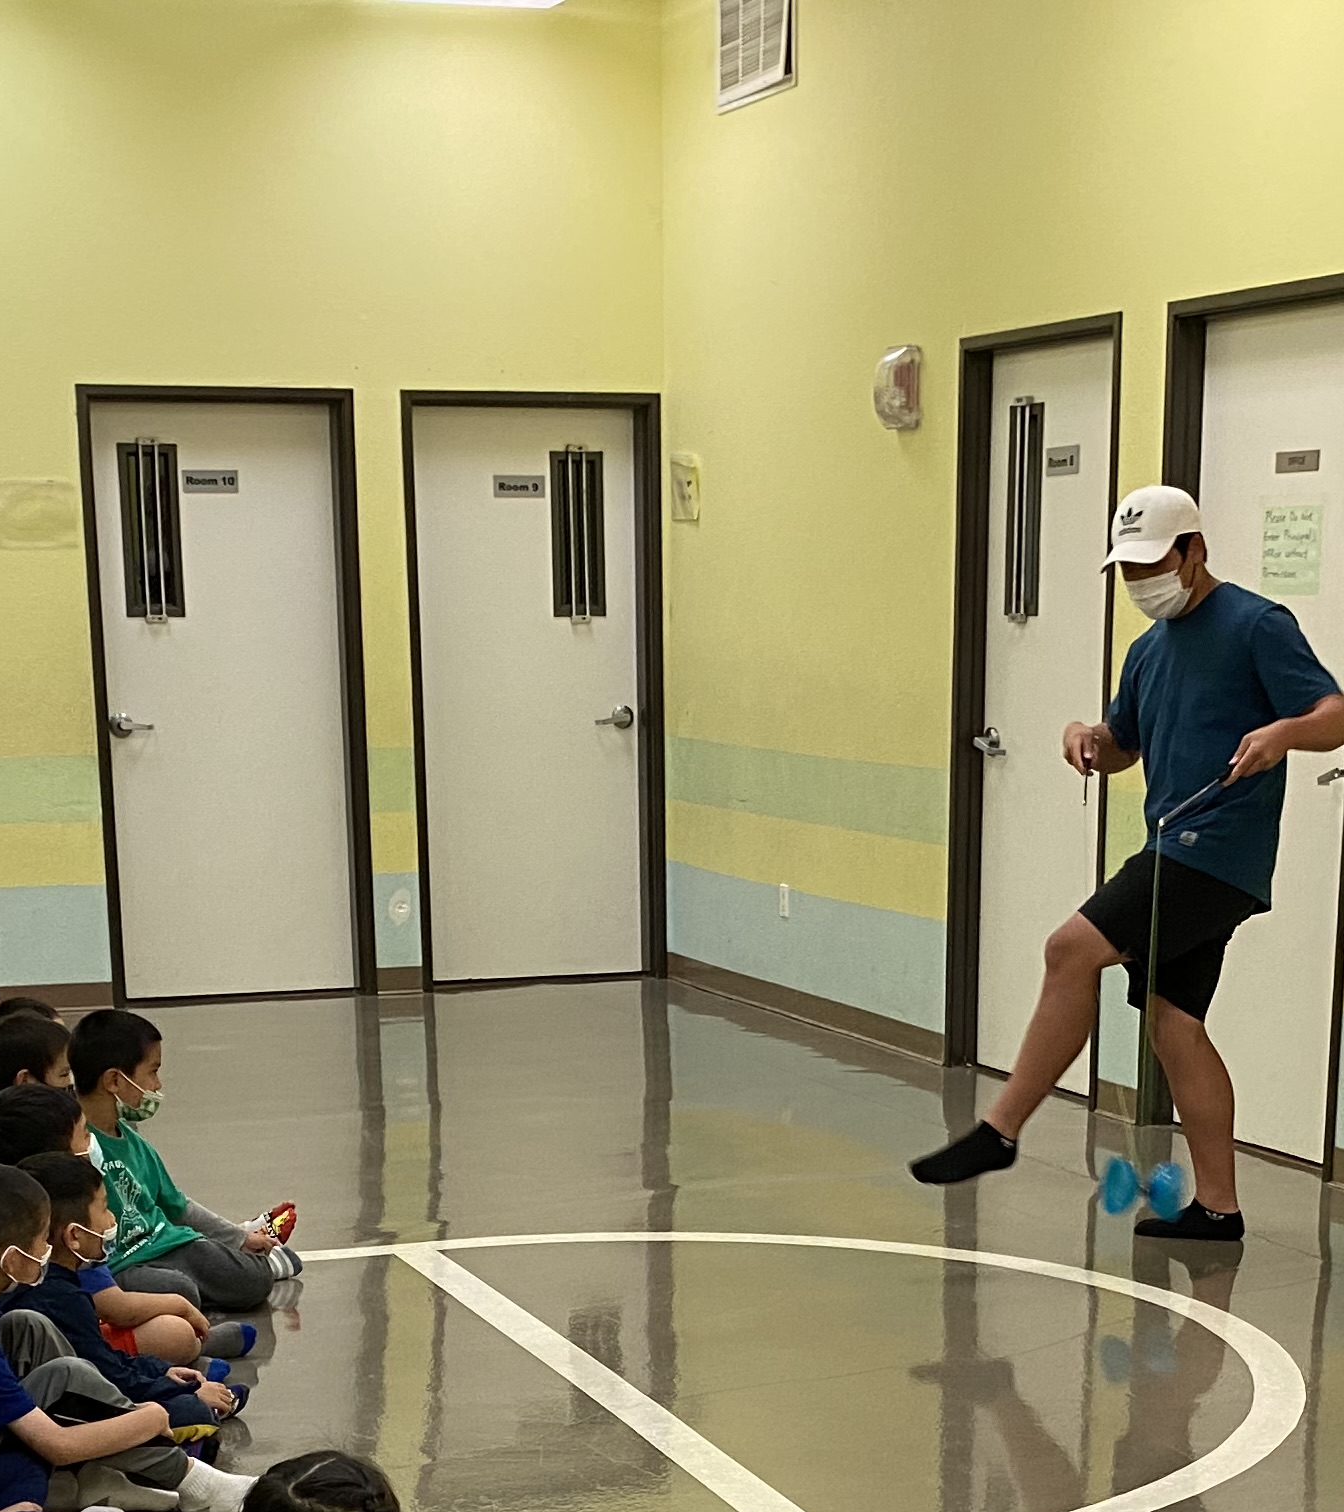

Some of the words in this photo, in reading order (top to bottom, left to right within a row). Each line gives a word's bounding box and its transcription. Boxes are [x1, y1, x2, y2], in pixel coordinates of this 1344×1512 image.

[186, 476, 218, 486] Room
[222, 476, 235, 486] 10
[498, 482, 529, 492] Room
[531, 482, 539, 492] 9
